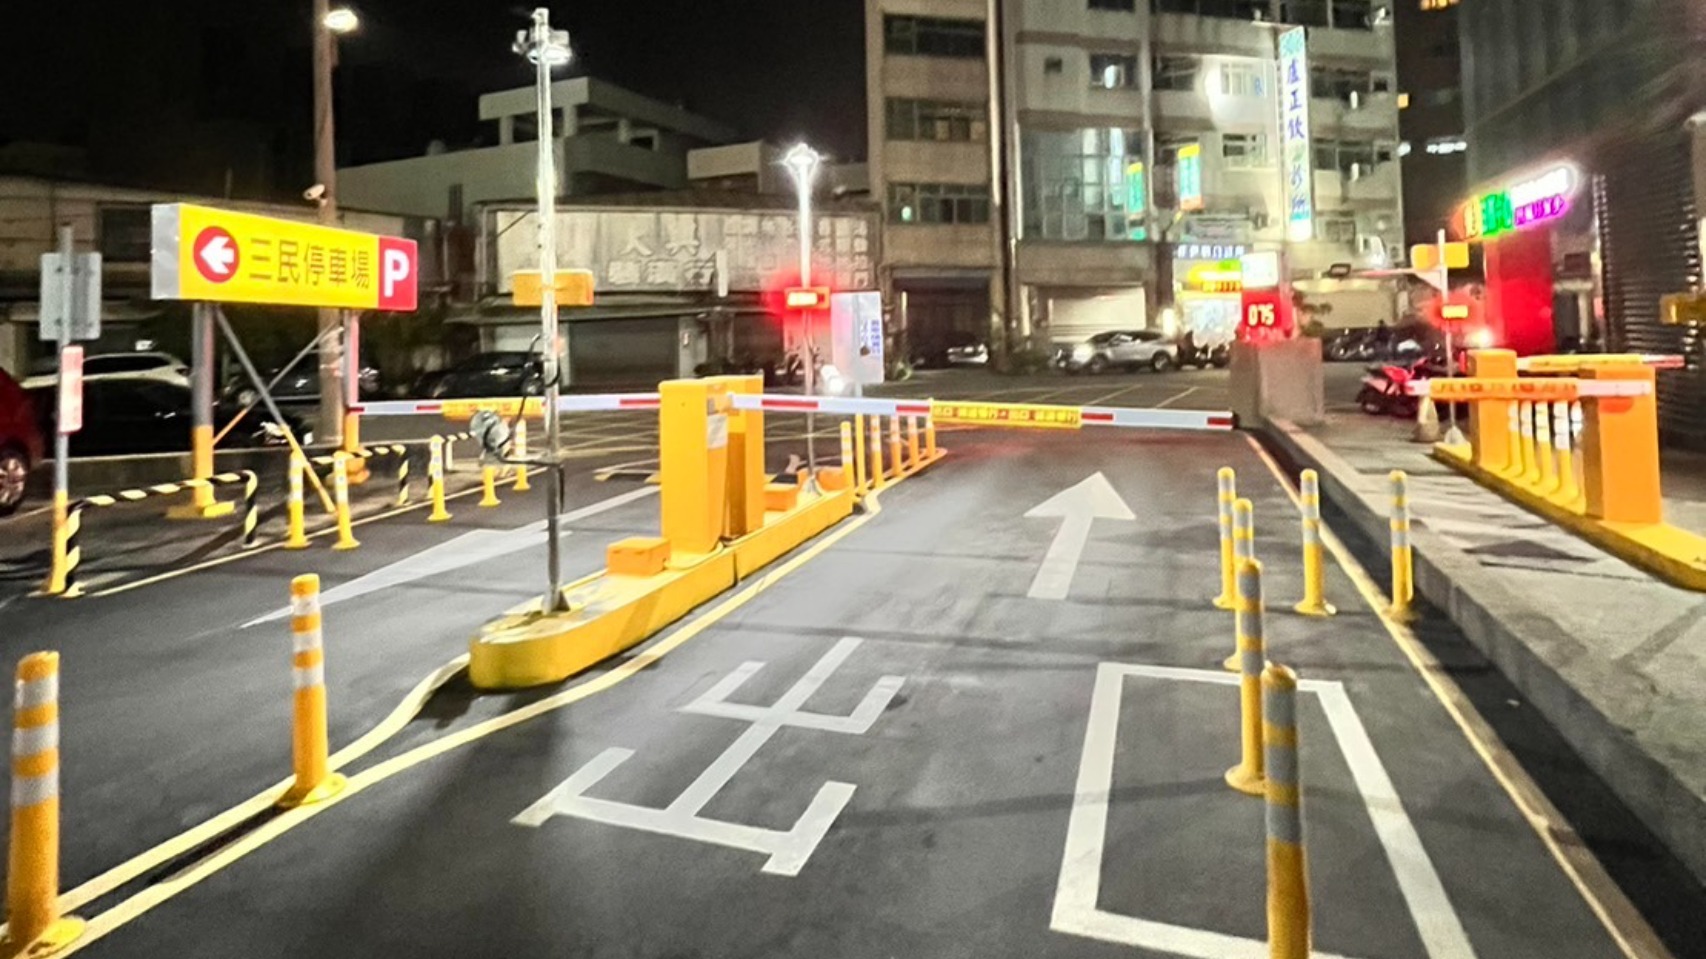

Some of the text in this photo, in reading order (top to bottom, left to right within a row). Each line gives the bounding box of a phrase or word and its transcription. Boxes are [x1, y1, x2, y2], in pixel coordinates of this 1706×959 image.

[249, 237, 410, 298] 三民停車場 P
